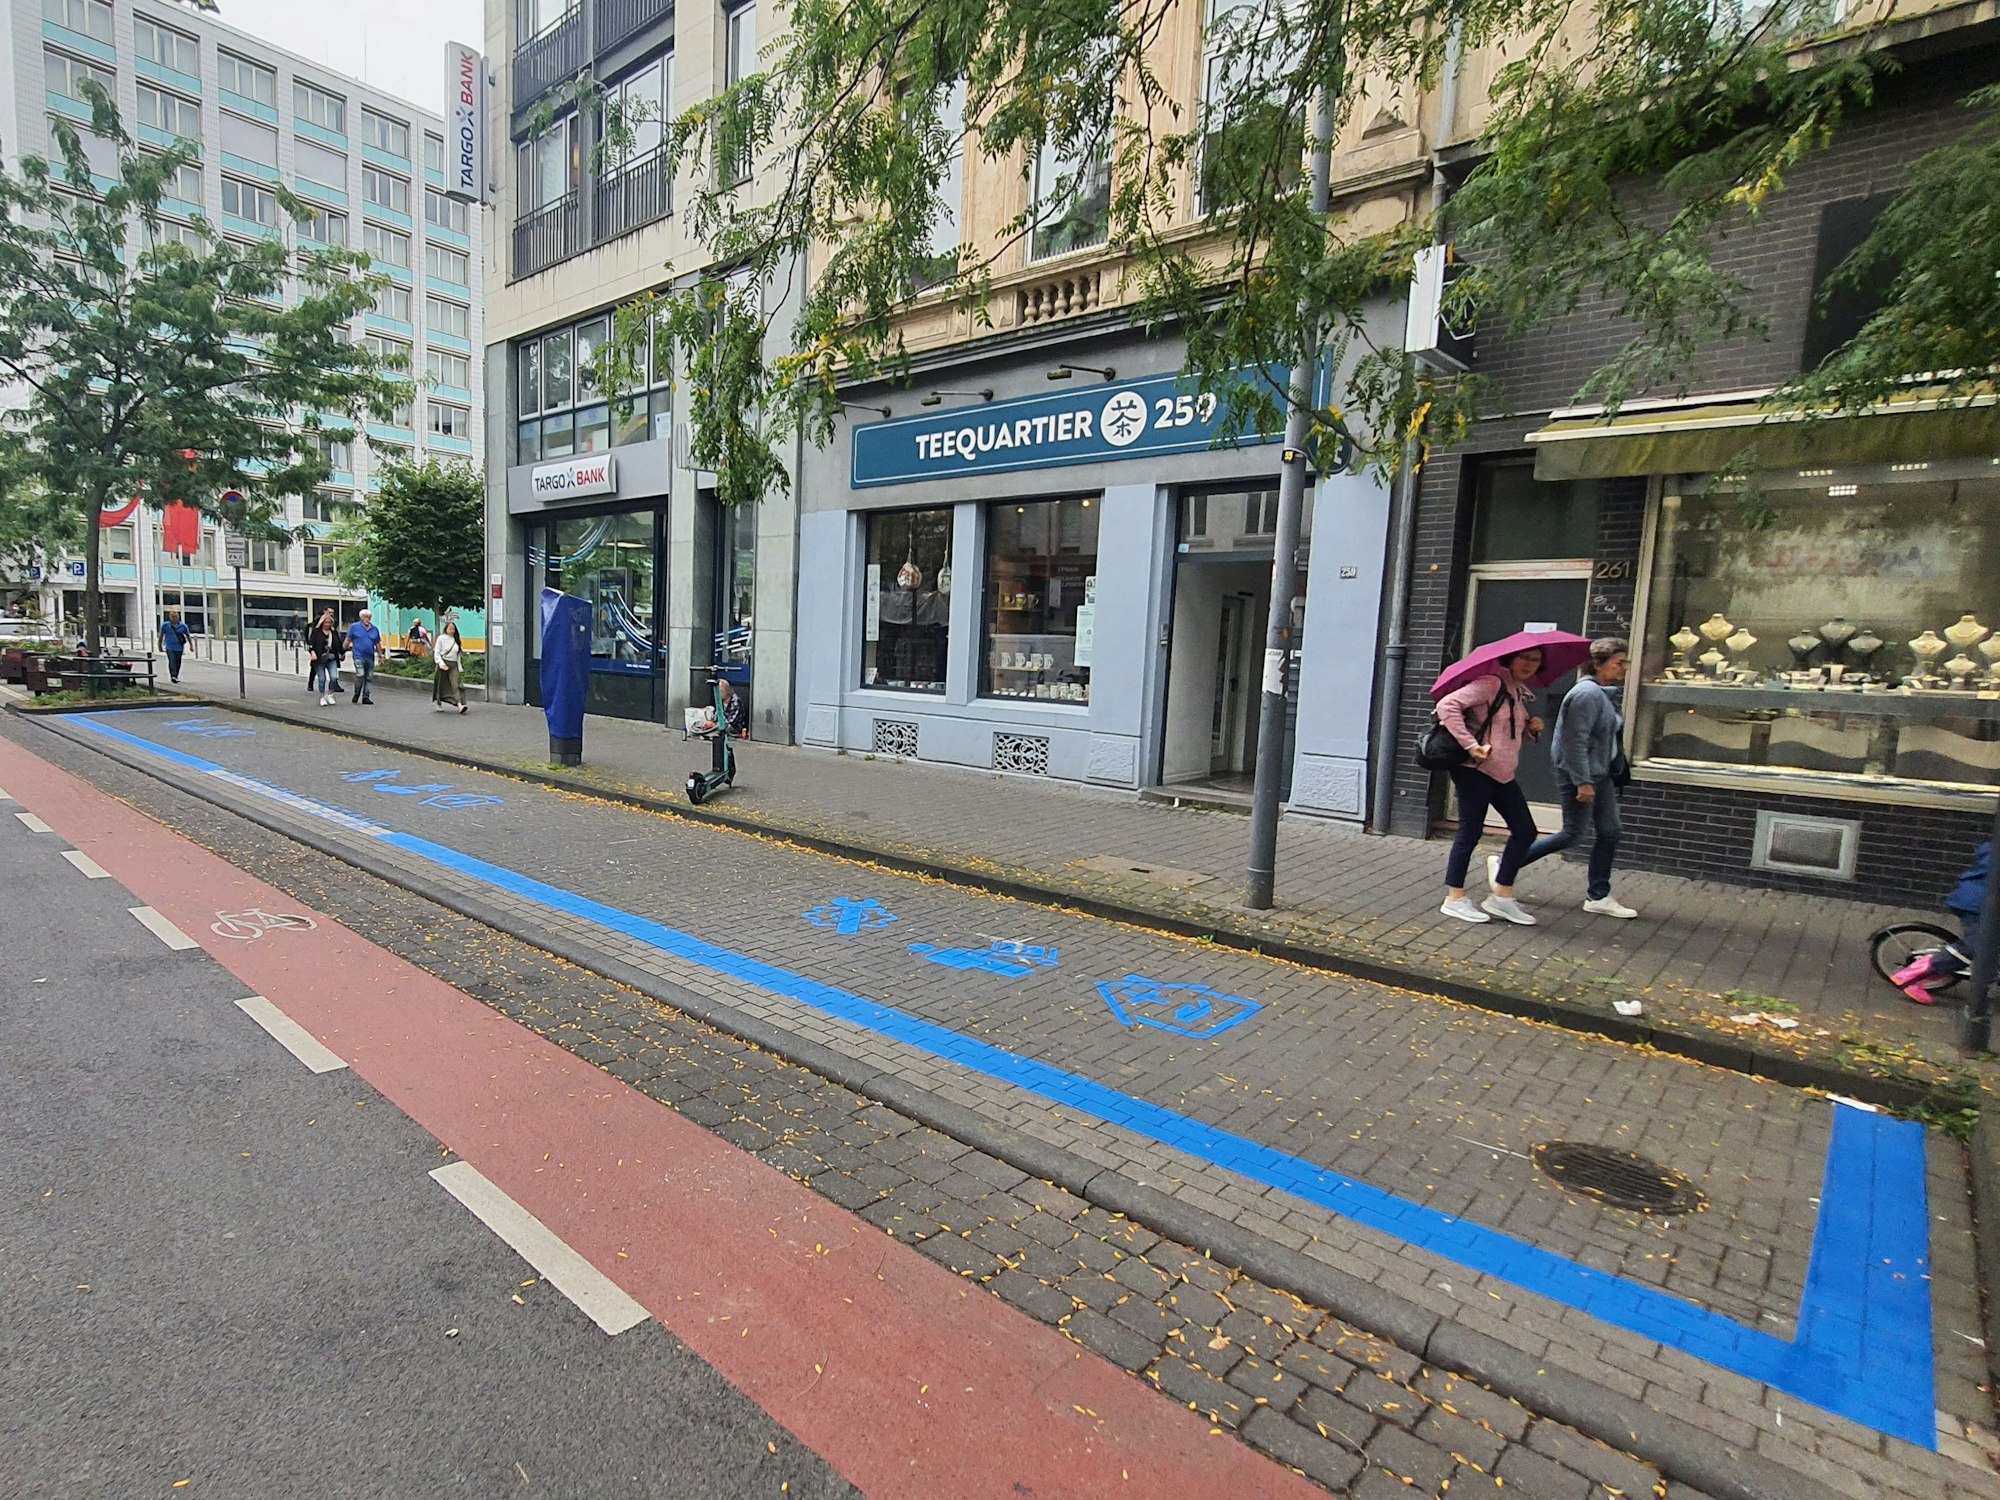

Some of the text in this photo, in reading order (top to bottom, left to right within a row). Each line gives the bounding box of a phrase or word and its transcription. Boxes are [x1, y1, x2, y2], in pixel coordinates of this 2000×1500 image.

[460, 50, 475, 188] TARGO BANK
[915, 391, 1217, 461] TEEQUARTIER 茶 259
[534, 466, 605, 492] TARGO BANK
[1595, 560, 1631, 579] 261
